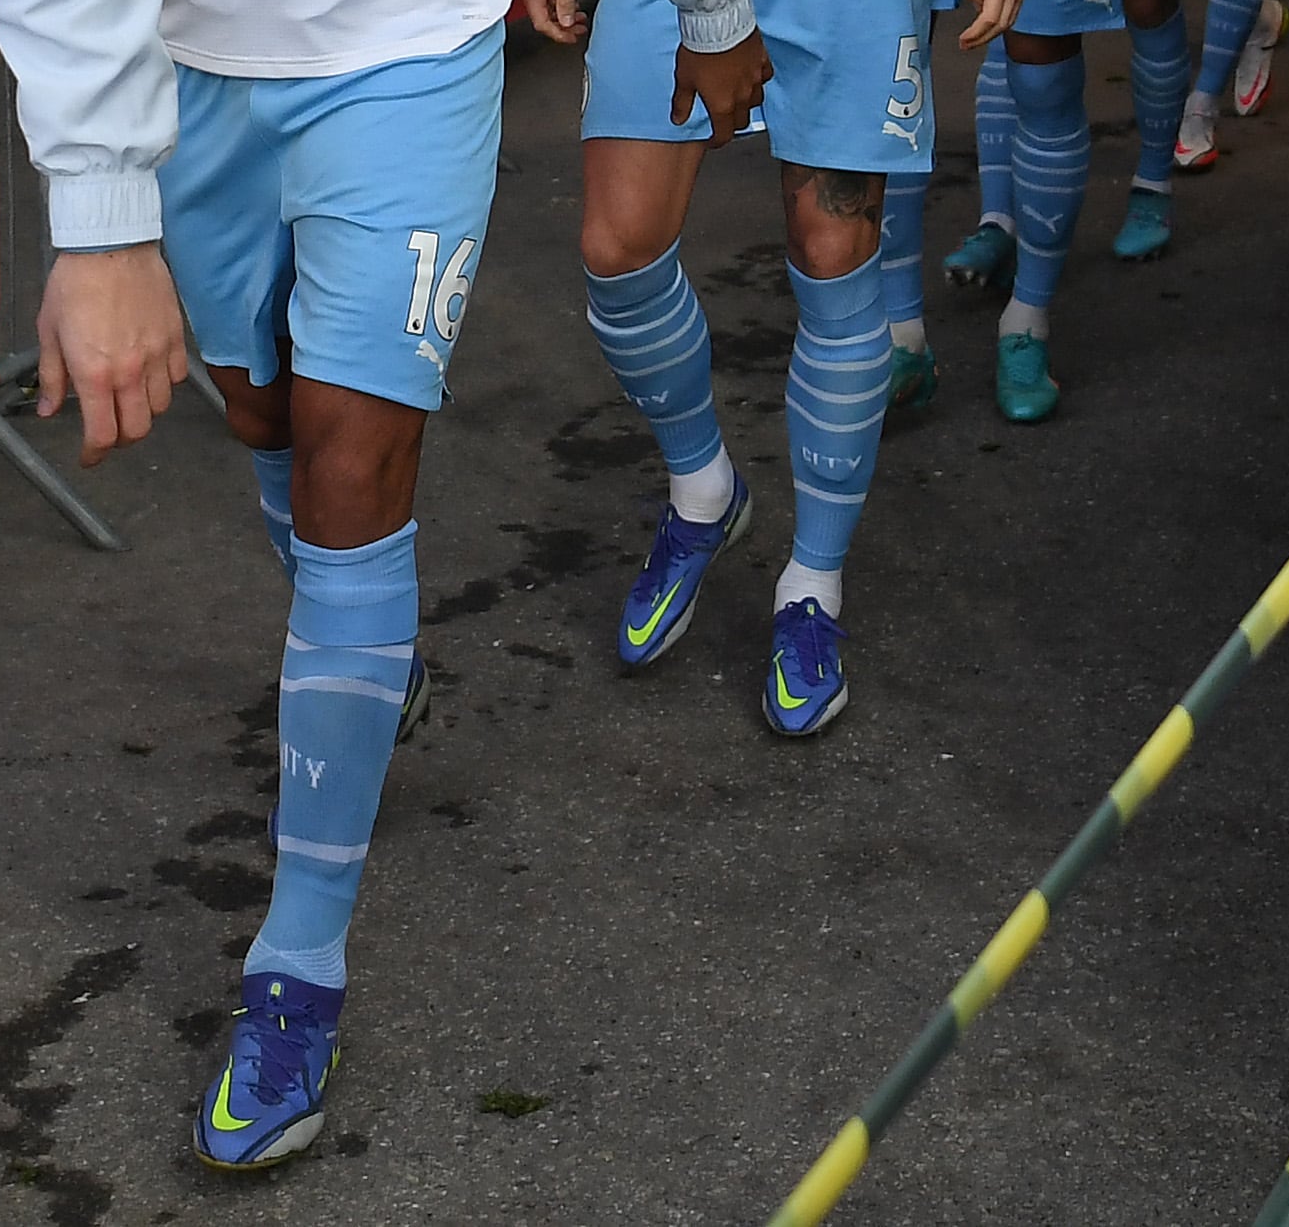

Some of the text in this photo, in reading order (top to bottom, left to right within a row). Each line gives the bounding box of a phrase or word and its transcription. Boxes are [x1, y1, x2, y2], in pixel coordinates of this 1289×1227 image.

[886, 34, 924, 119] 5
[404, 229, 476, 341] 16
[623, 390, 669, 406] ITY
[802, 446, 862, 471] CITY
[281, 742, 326, 789] ITY
